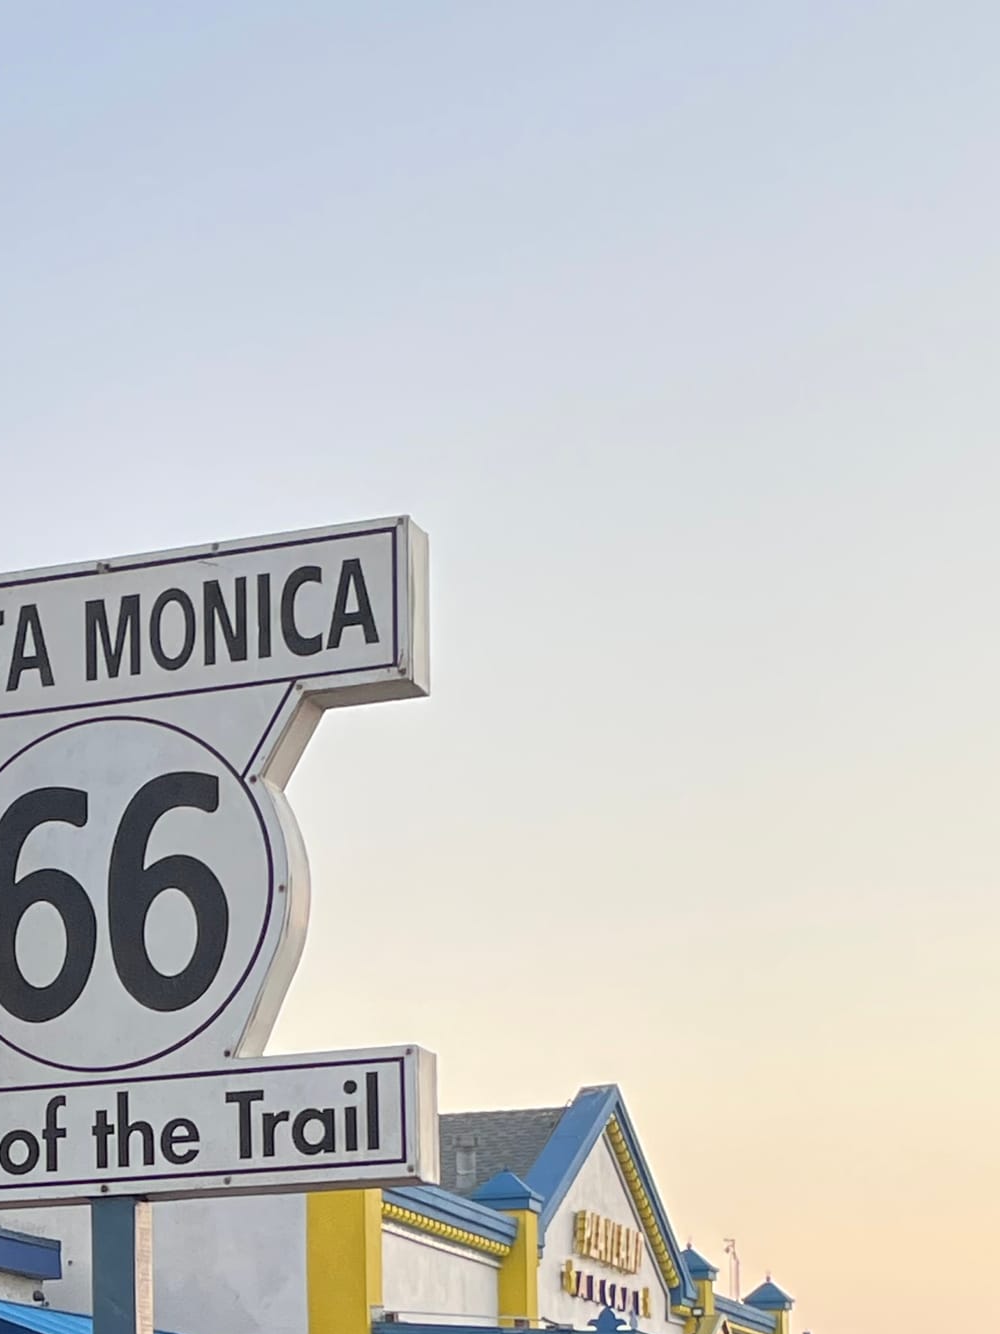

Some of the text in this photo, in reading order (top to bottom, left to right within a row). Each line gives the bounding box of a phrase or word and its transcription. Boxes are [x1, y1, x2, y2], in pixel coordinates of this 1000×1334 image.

[84, 557, 380, 682] MONICA
[91, 1090, 201, 1170] the
[225, 1070, 379, 1160] Trail
